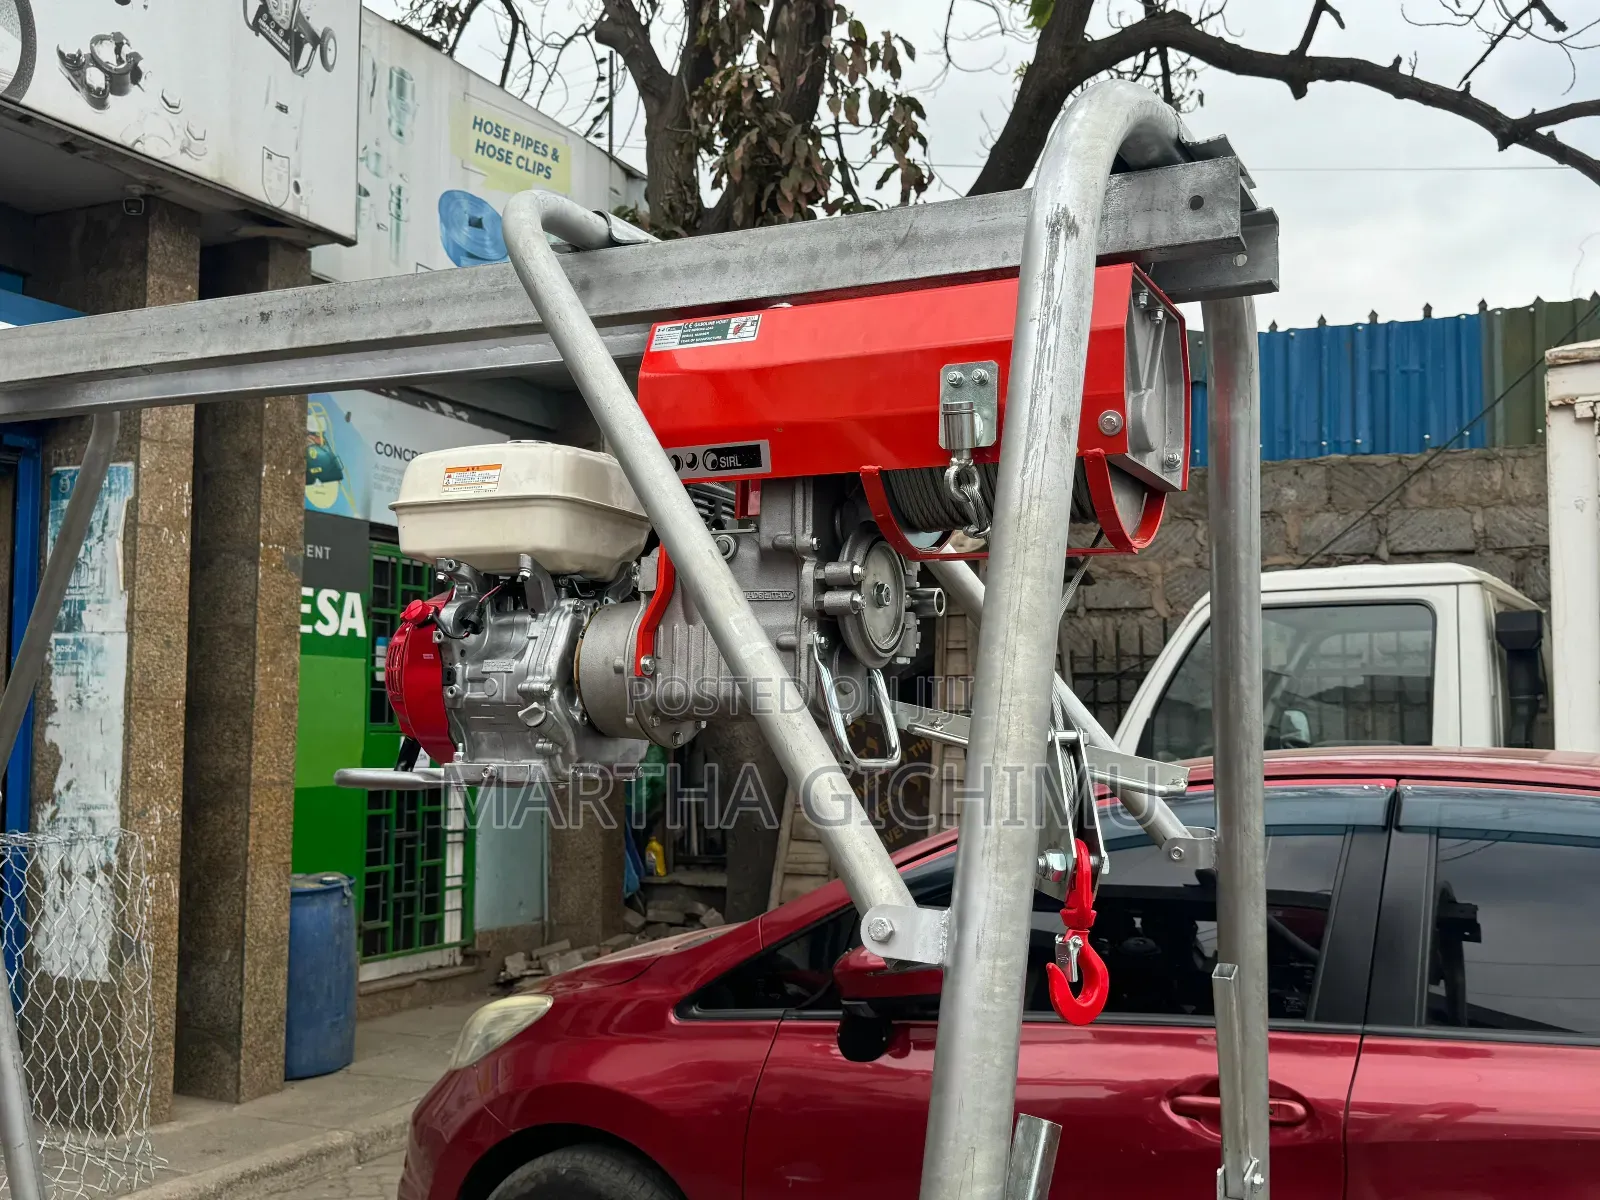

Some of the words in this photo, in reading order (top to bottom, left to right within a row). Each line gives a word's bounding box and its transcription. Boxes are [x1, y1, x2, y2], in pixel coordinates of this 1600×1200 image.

[472, 115, 511, 143] HOSE
[512, 131, 549, 158] PIPES
[550, 147, 560, 163] &
[475, 138, 513, 165] HOSE
[515, 155, 552, 180] CLIPS
[720, 455, 742, 468] SIRL
[303, 544, 331, 560] ENT
